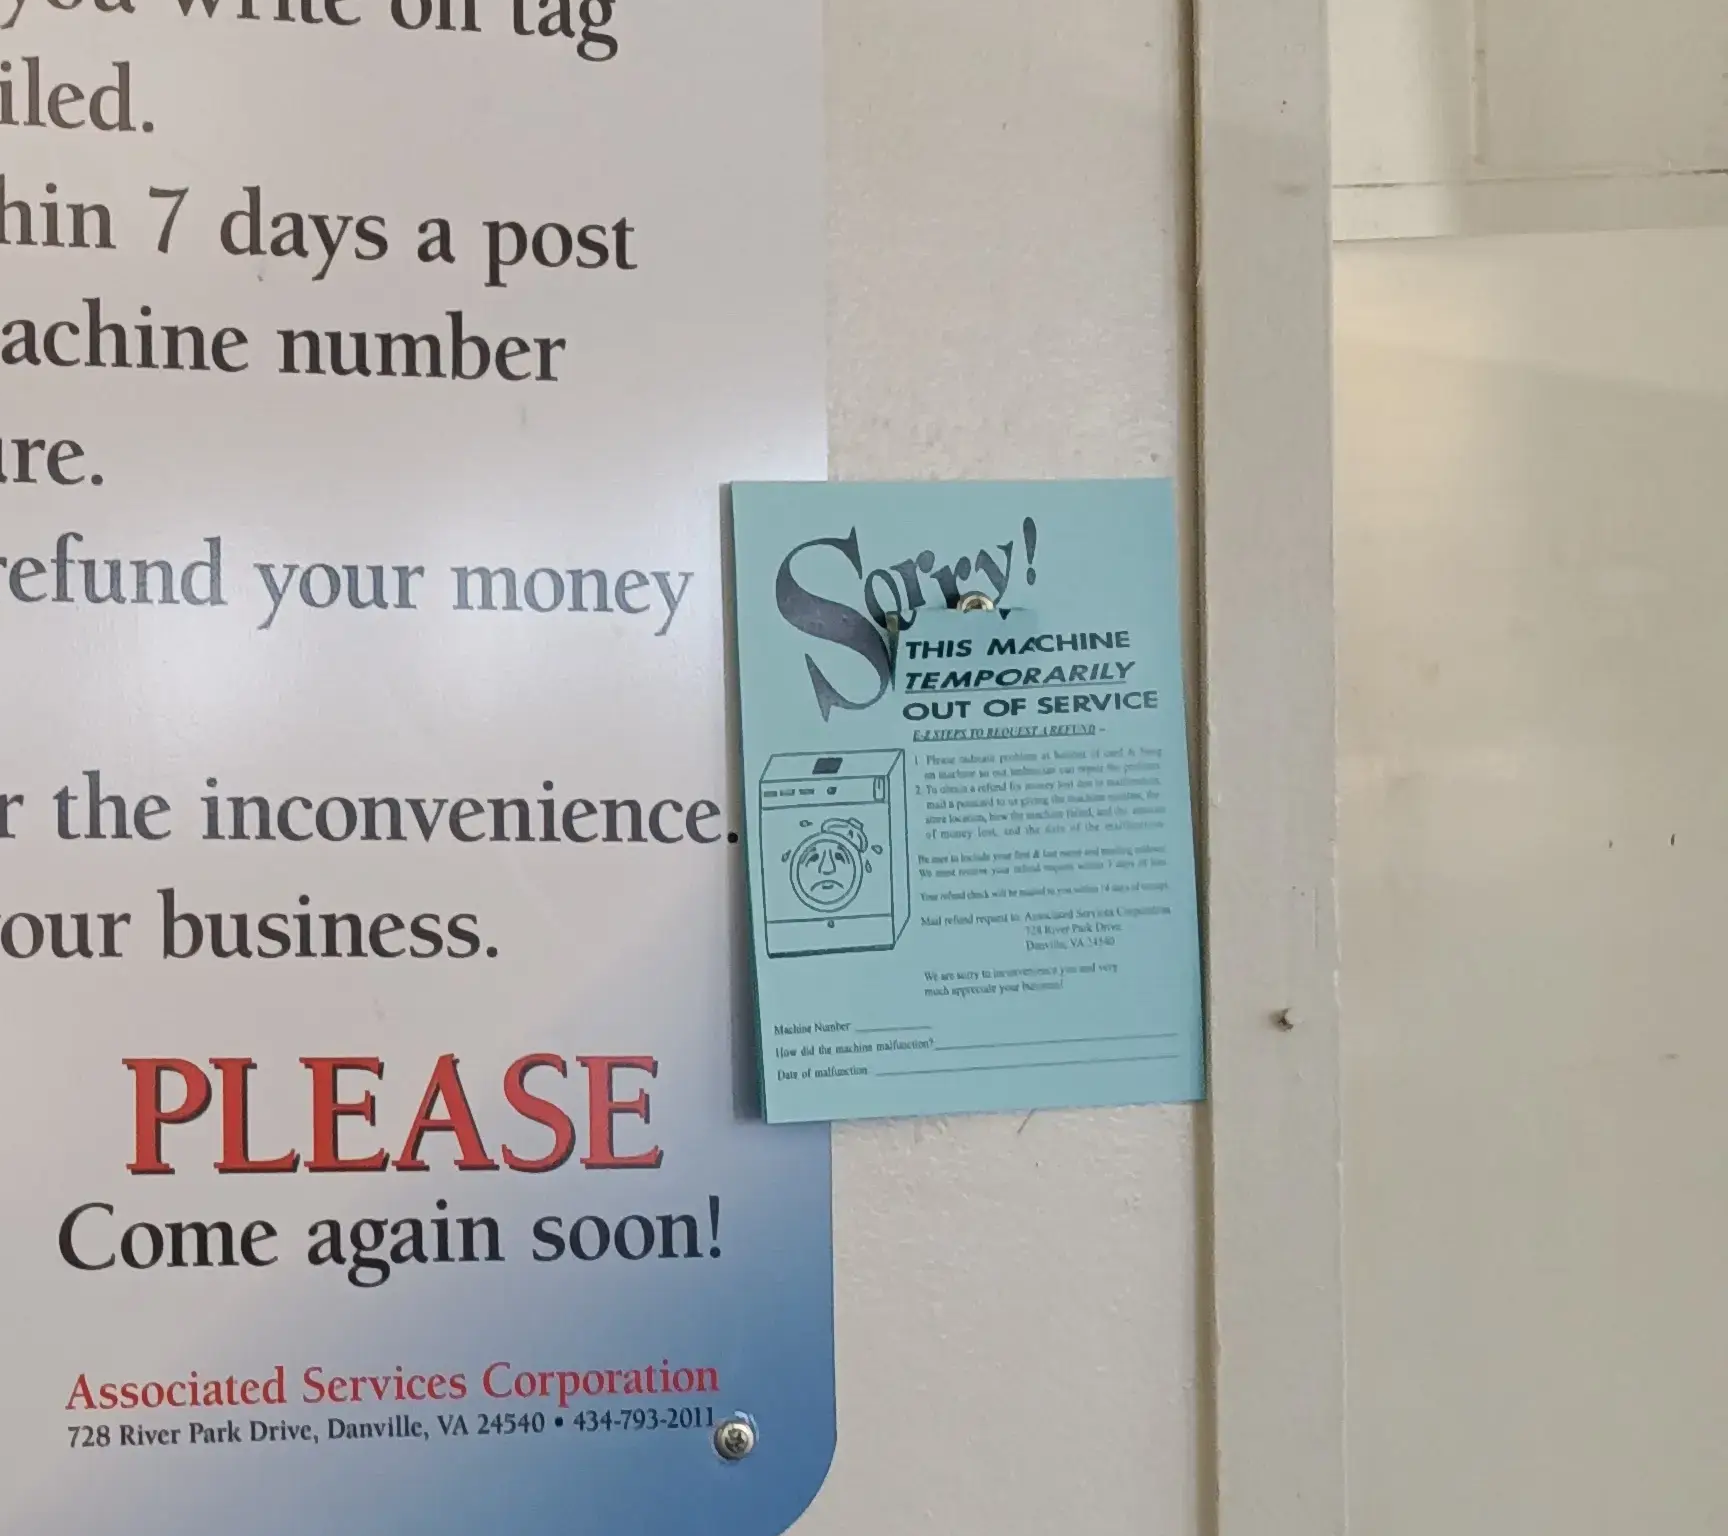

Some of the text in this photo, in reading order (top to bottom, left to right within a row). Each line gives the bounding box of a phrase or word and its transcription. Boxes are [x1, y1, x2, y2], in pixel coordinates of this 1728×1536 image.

[149, 186, 188, 253] 7
[221, 187, 388, 281] days
[418, 218, 455, 263] a
[483, 217, 637, 287] post
[277, 311, 566, 381] number
[254, 563, 424, 630] your
[451, 566, 694, 636] money
[776, 517, 1038, 722] Sorry!
[906, 631, 1129, 659] THIS MACHINE
[903, 691, 1157, 720] OUT OF SERVICE
[905, 662, 1135, 694] TEMPORARILY
[53, 770, 171, 840] the
[201, 775, 741, 846] inconvenience.
[157, 888, 497, 959] business.
[801, 1046, 814, 1056] did
[814, 1022, 852, 1032] Number
[801, 1068, 811, 1079] of
[122, 1053, 663, 1175] PLEASE
[59, 1196, 720, 1287] Come again soon!
[65, 1359, 719, 1410] Associated Services Corporation
[68, 1407, 713, 1447] 728 River Park Drive, Danville, VA 24540 434-793-2011
